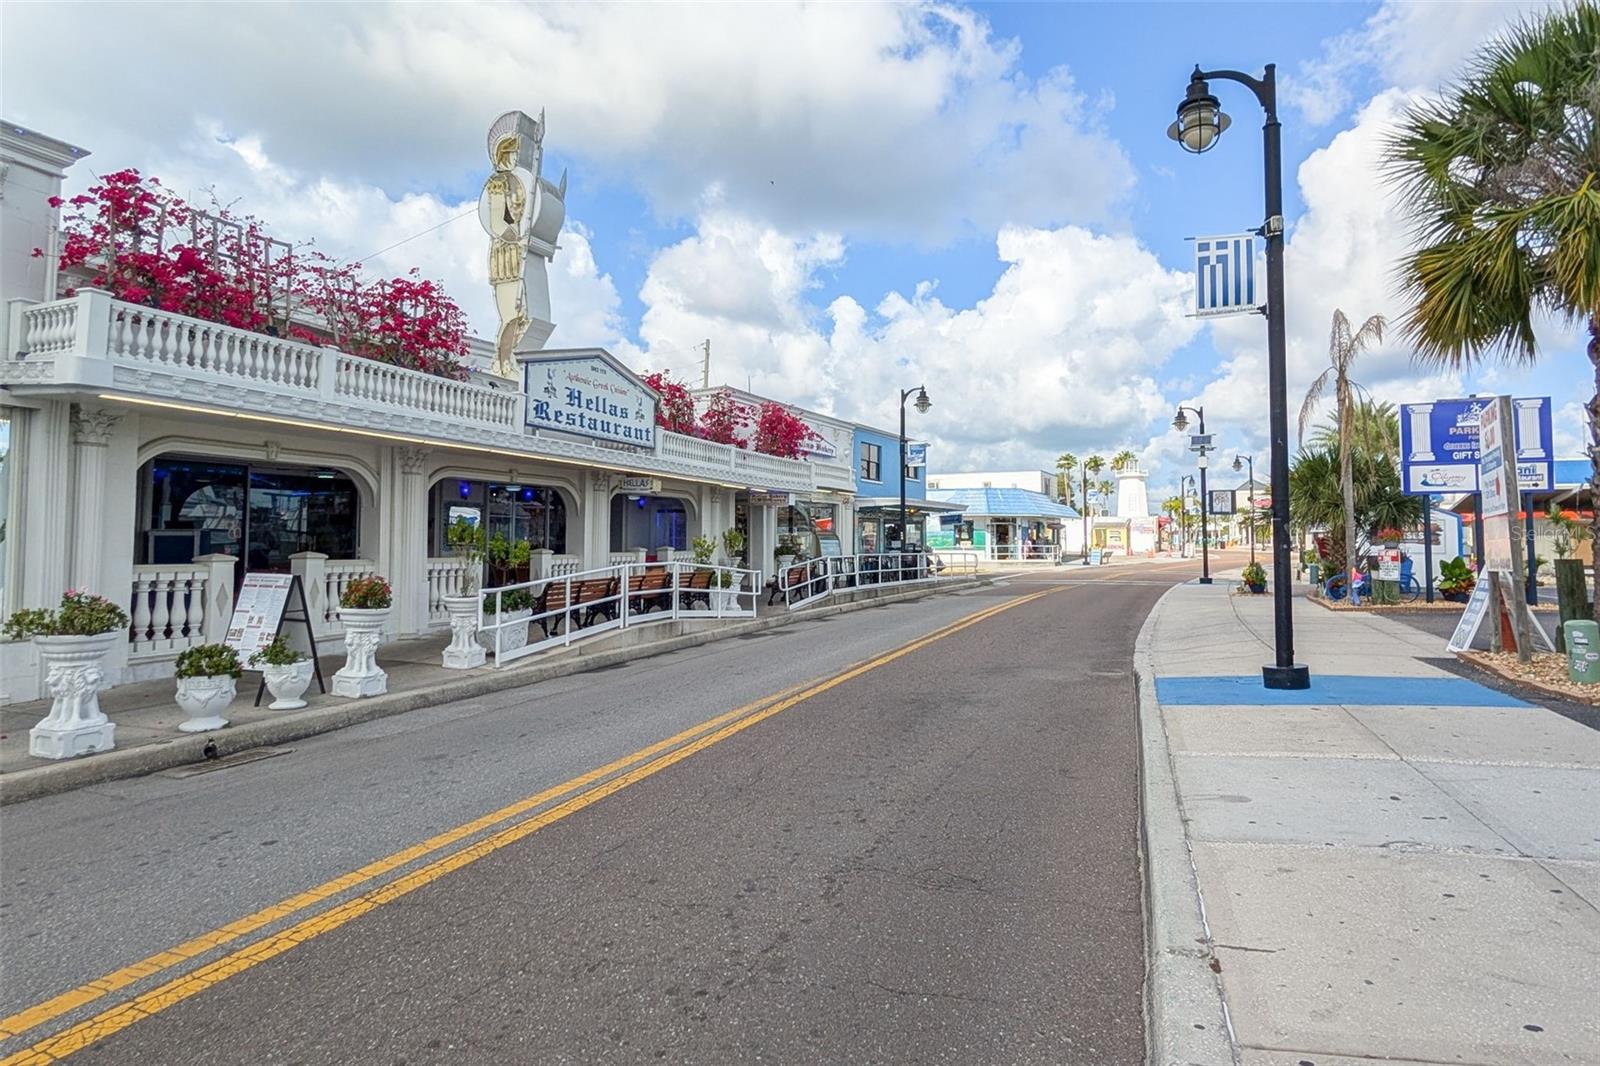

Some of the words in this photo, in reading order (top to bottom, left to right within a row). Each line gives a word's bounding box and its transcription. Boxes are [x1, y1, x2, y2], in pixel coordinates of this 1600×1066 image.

[565, 386, 629, 419] Hellas
[533, 398, 651, 442] Restaurant
[1449, 427, 1480, 436] PARK
[1452, 451, 1473, 460] GIFT
